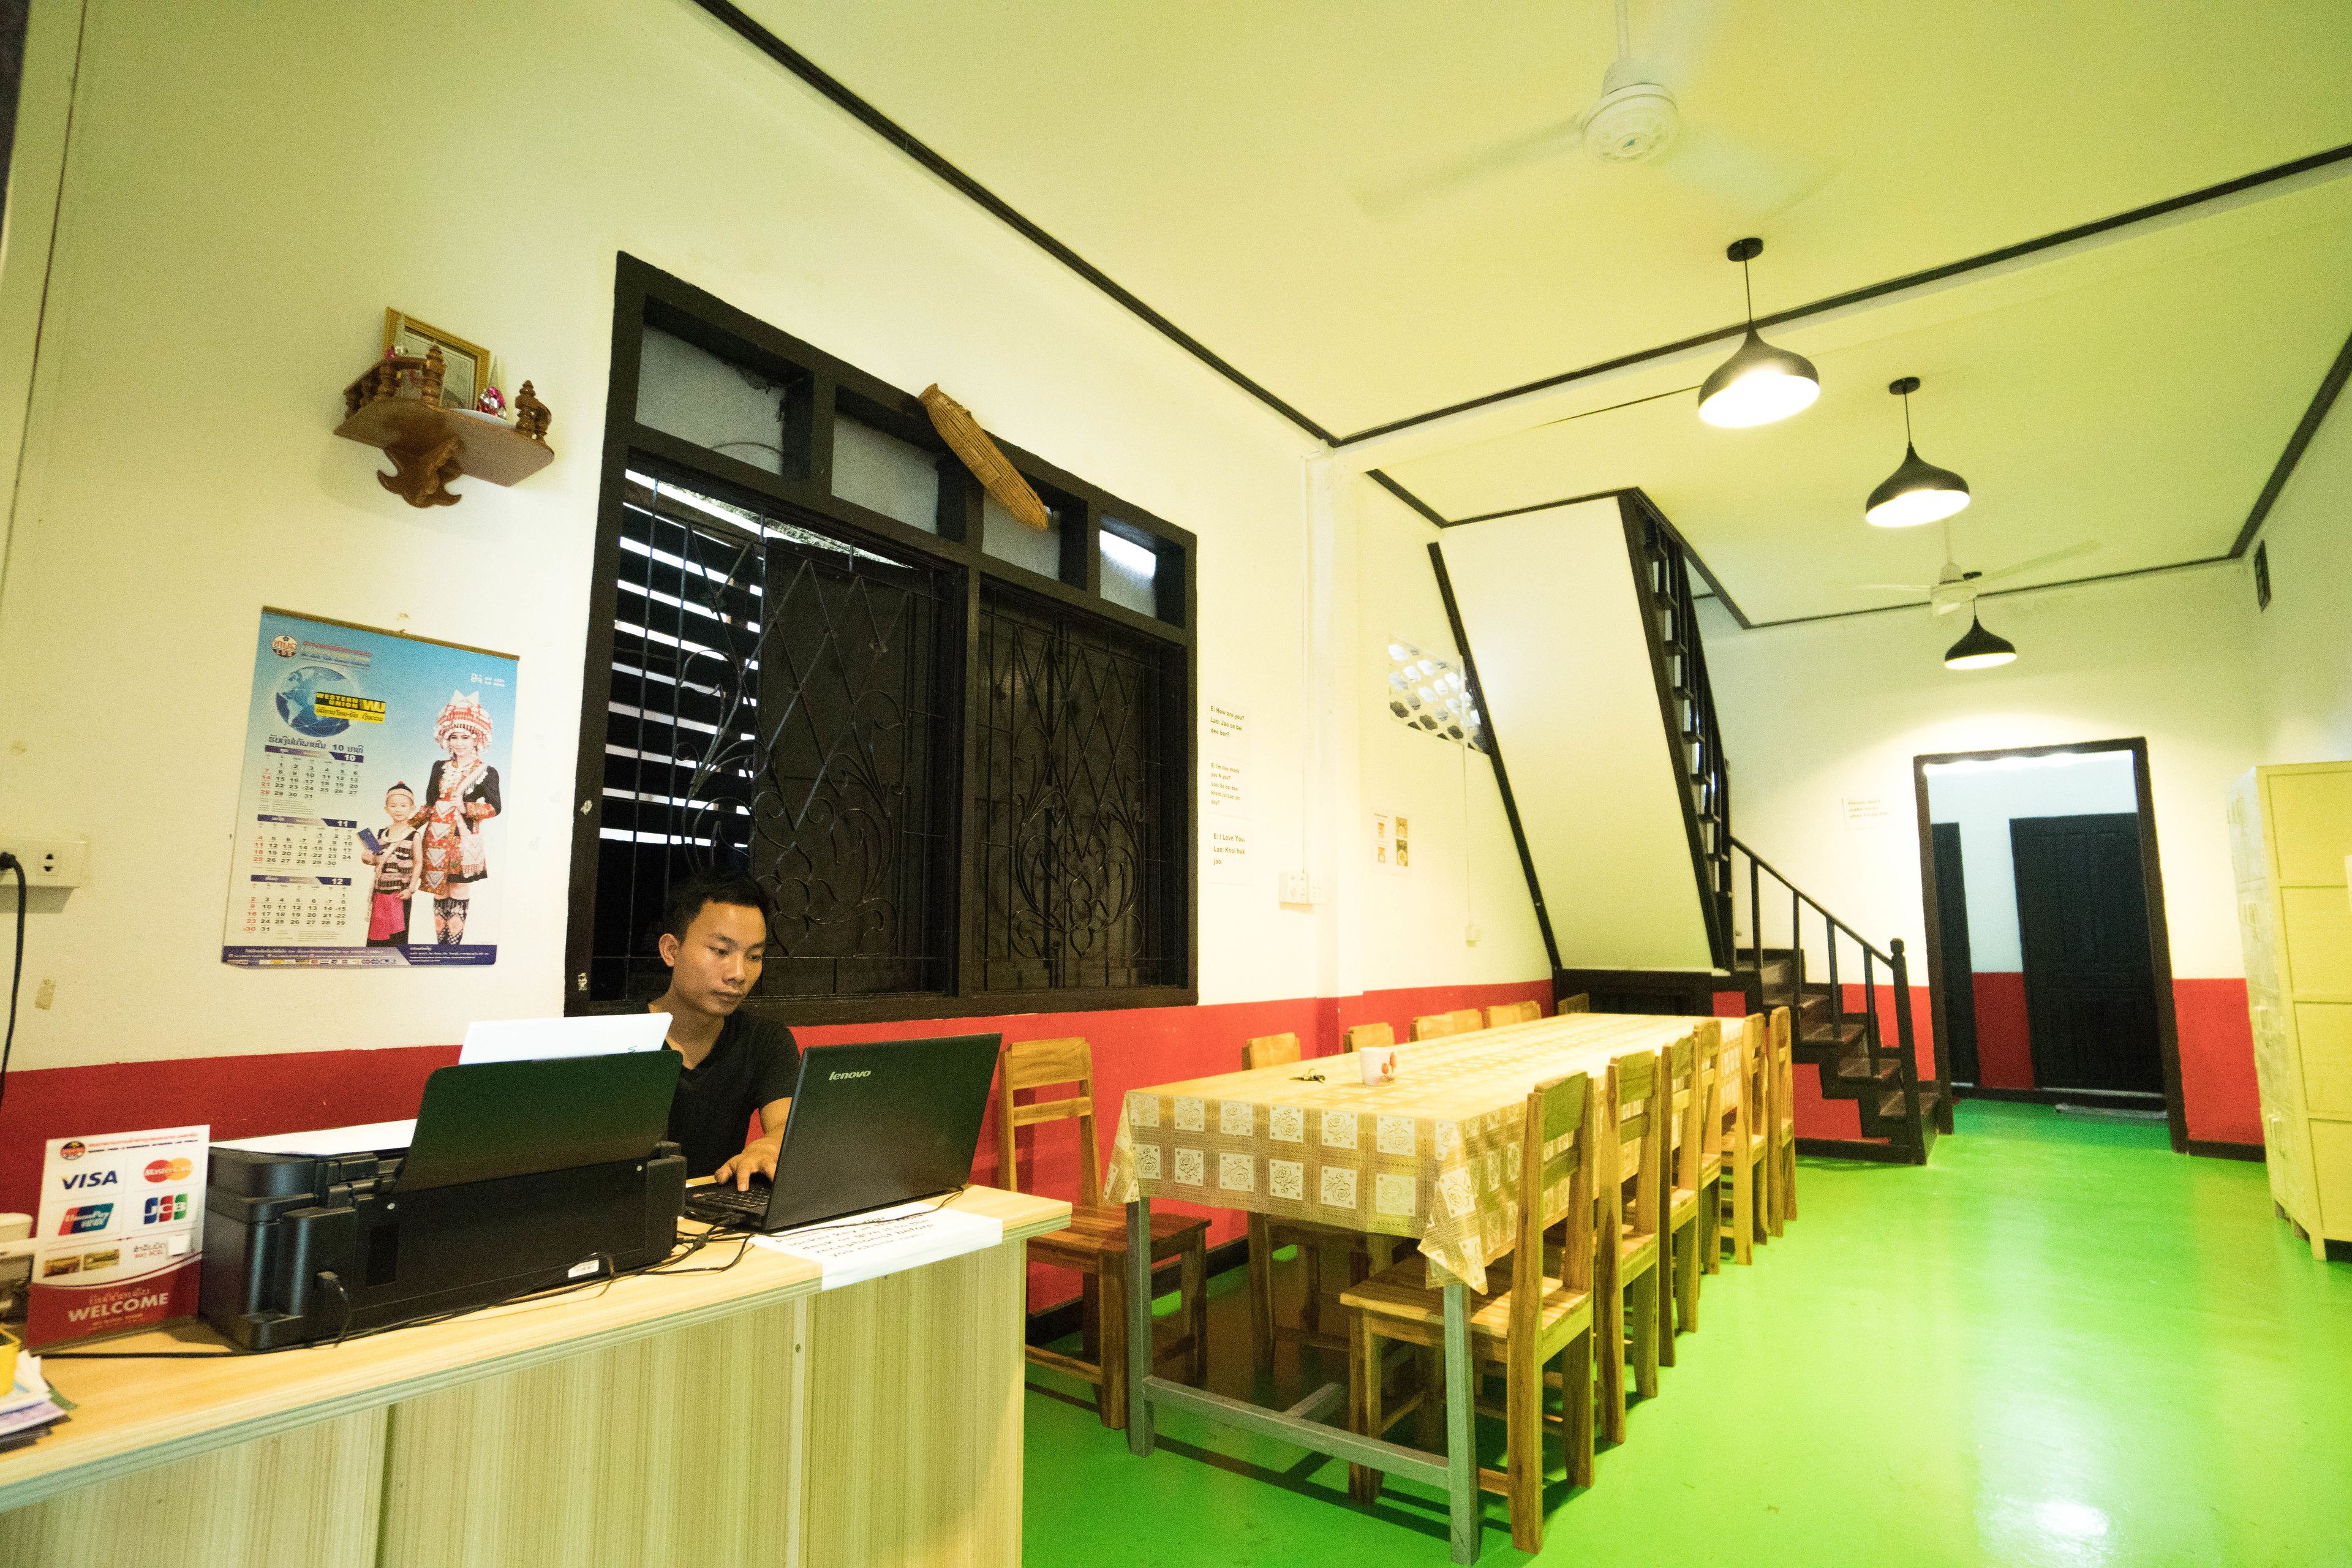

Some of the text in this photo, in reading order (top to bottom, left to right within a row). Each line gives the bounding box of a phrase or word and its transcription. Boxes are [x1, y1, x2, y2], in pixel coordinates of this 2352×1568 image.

[316, 693, 386, 712] WESTERN WU
[829, 1070, 871, 1080] lenovo
[62, 1170, 118, 1190] VISA
[144, 1197, 187, 1221] JCB
[894, 1223, 934, 1235] before
[68, 1292, 168, 1322] WELCOME
